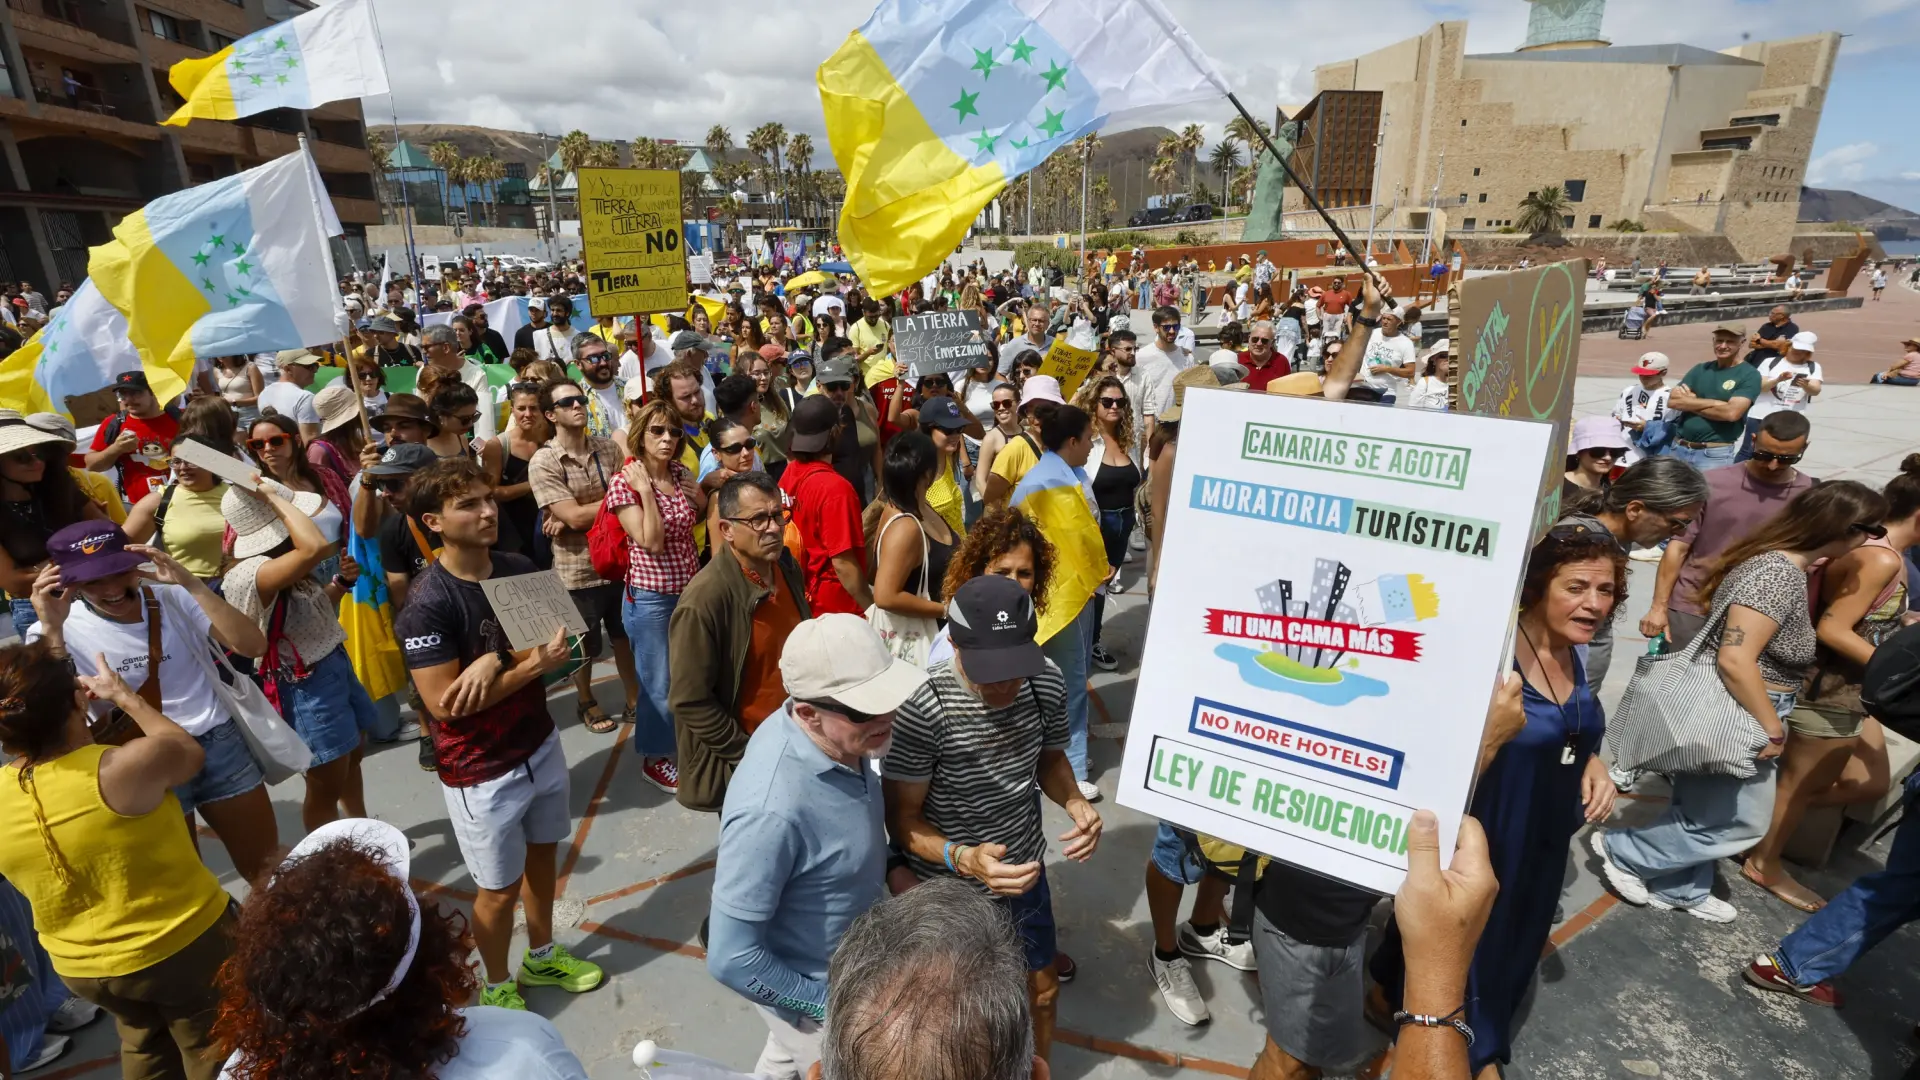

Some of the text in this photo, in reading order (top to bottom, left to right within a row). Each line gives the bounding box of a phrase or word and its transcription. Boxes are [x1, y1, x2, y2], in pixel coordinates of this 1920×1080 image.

[590, 198, 636, 215] TIERRA
[617, 214, 660, 232] TIERRA
[645, 229, 678, 254] NO
[590, 254, 635, 269] PODEMOS
[590, 271, 639, 293] TIERRA
[895, 311, 968, 333] LA TIERRA
[901, 329, 972, 351] del fuego
[934, 343, 987, 360] EMPEZANDO
[909, 362, 920, 378] A
[1248, 429, 1461, 482] CANARIAS SE AGOTA
[1201, 479, 1341, 528] MORATORIA
[1356, 506, 1490, 557] TURÍSTICA
[69, 532, 114, 549] TOUCH
[494, 573, 565, 607] CANARIAS
[501, 600, 548, 623] TIENE
[517, 612, 580, 643] LIMITE
[1222, 615, 1394, 655] NI UNA CAMA MÁS
[116, 665, 130, 673] NO
[1200, 711, 1387, 774] NO MORE HOTELS!
[1153, 748, 1204, 791] LEY
[1209, 765, 1247, 806] DE
